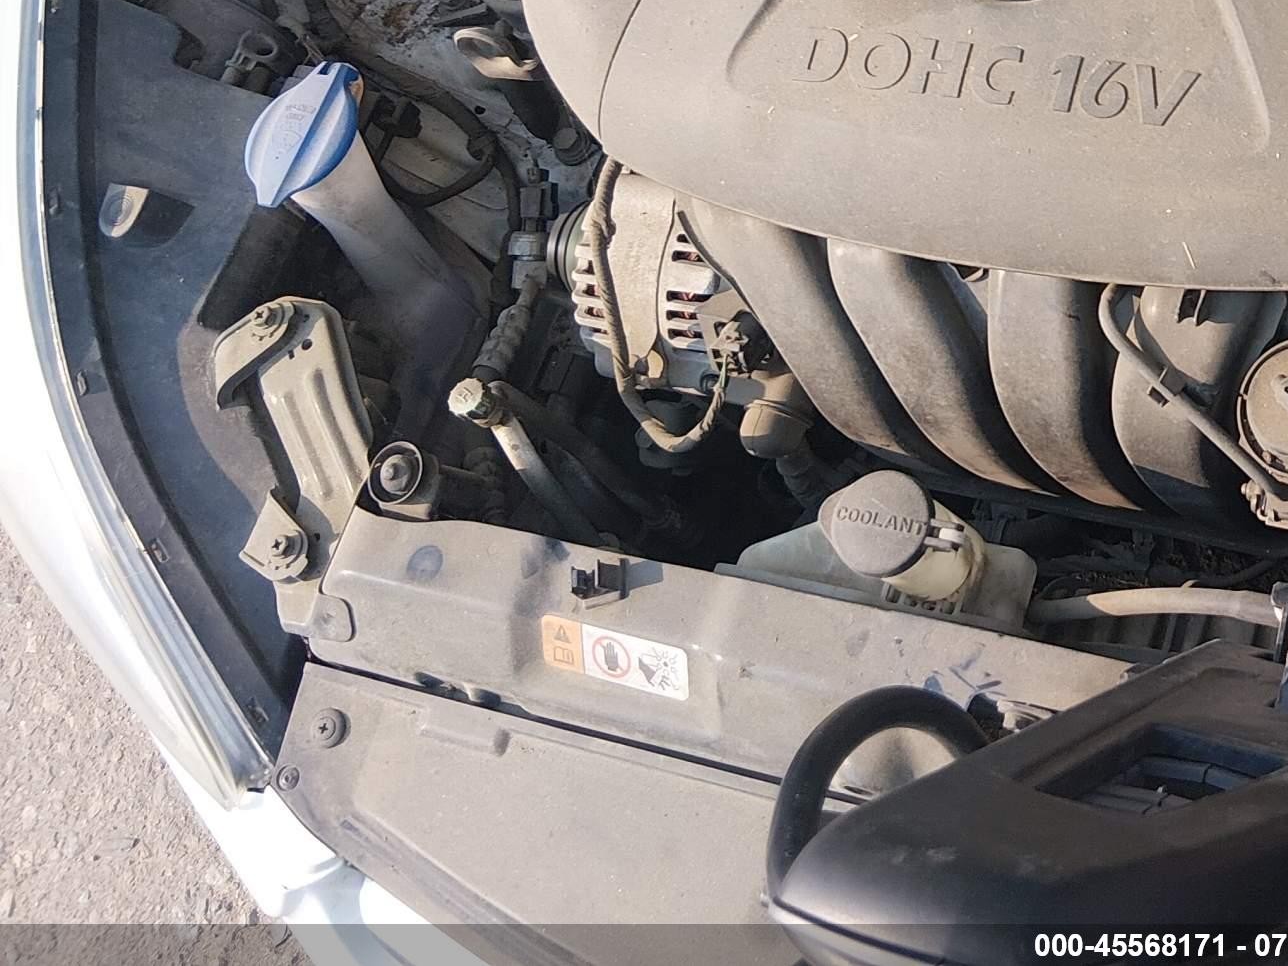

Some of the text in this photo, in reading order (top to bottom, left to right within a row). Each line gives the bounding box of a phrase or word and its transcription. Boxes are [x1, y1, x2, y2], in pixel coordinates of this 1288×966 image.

[792, 27, 1204, 127] DOHC 16V
[836, 505, 928, 537] COOLANT
